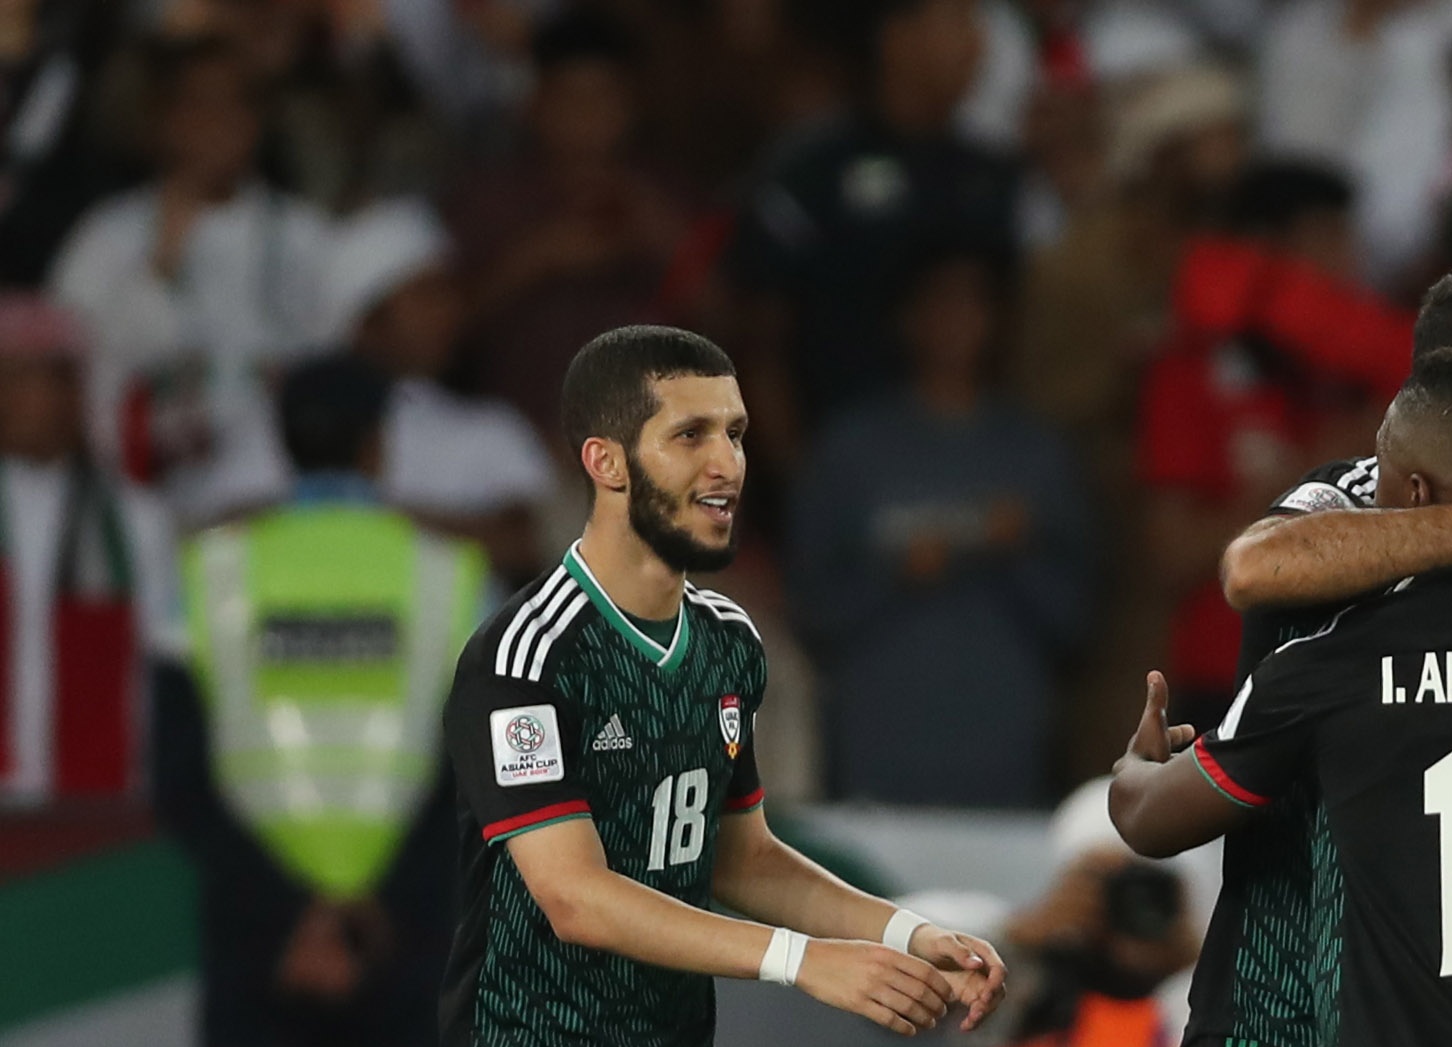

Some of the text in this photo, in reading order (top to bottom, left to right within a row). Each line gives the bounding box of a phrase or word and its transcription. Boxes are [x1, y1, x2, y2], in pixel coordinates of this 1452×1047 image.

[1382, 656, 1406, 704] I.
[592, 736, 633, 751] adidas
[520, 753, 537, 762] AFC
[501, 759, 557, 773] ASIAN CUP
[647, 768, 709, 871] 18
